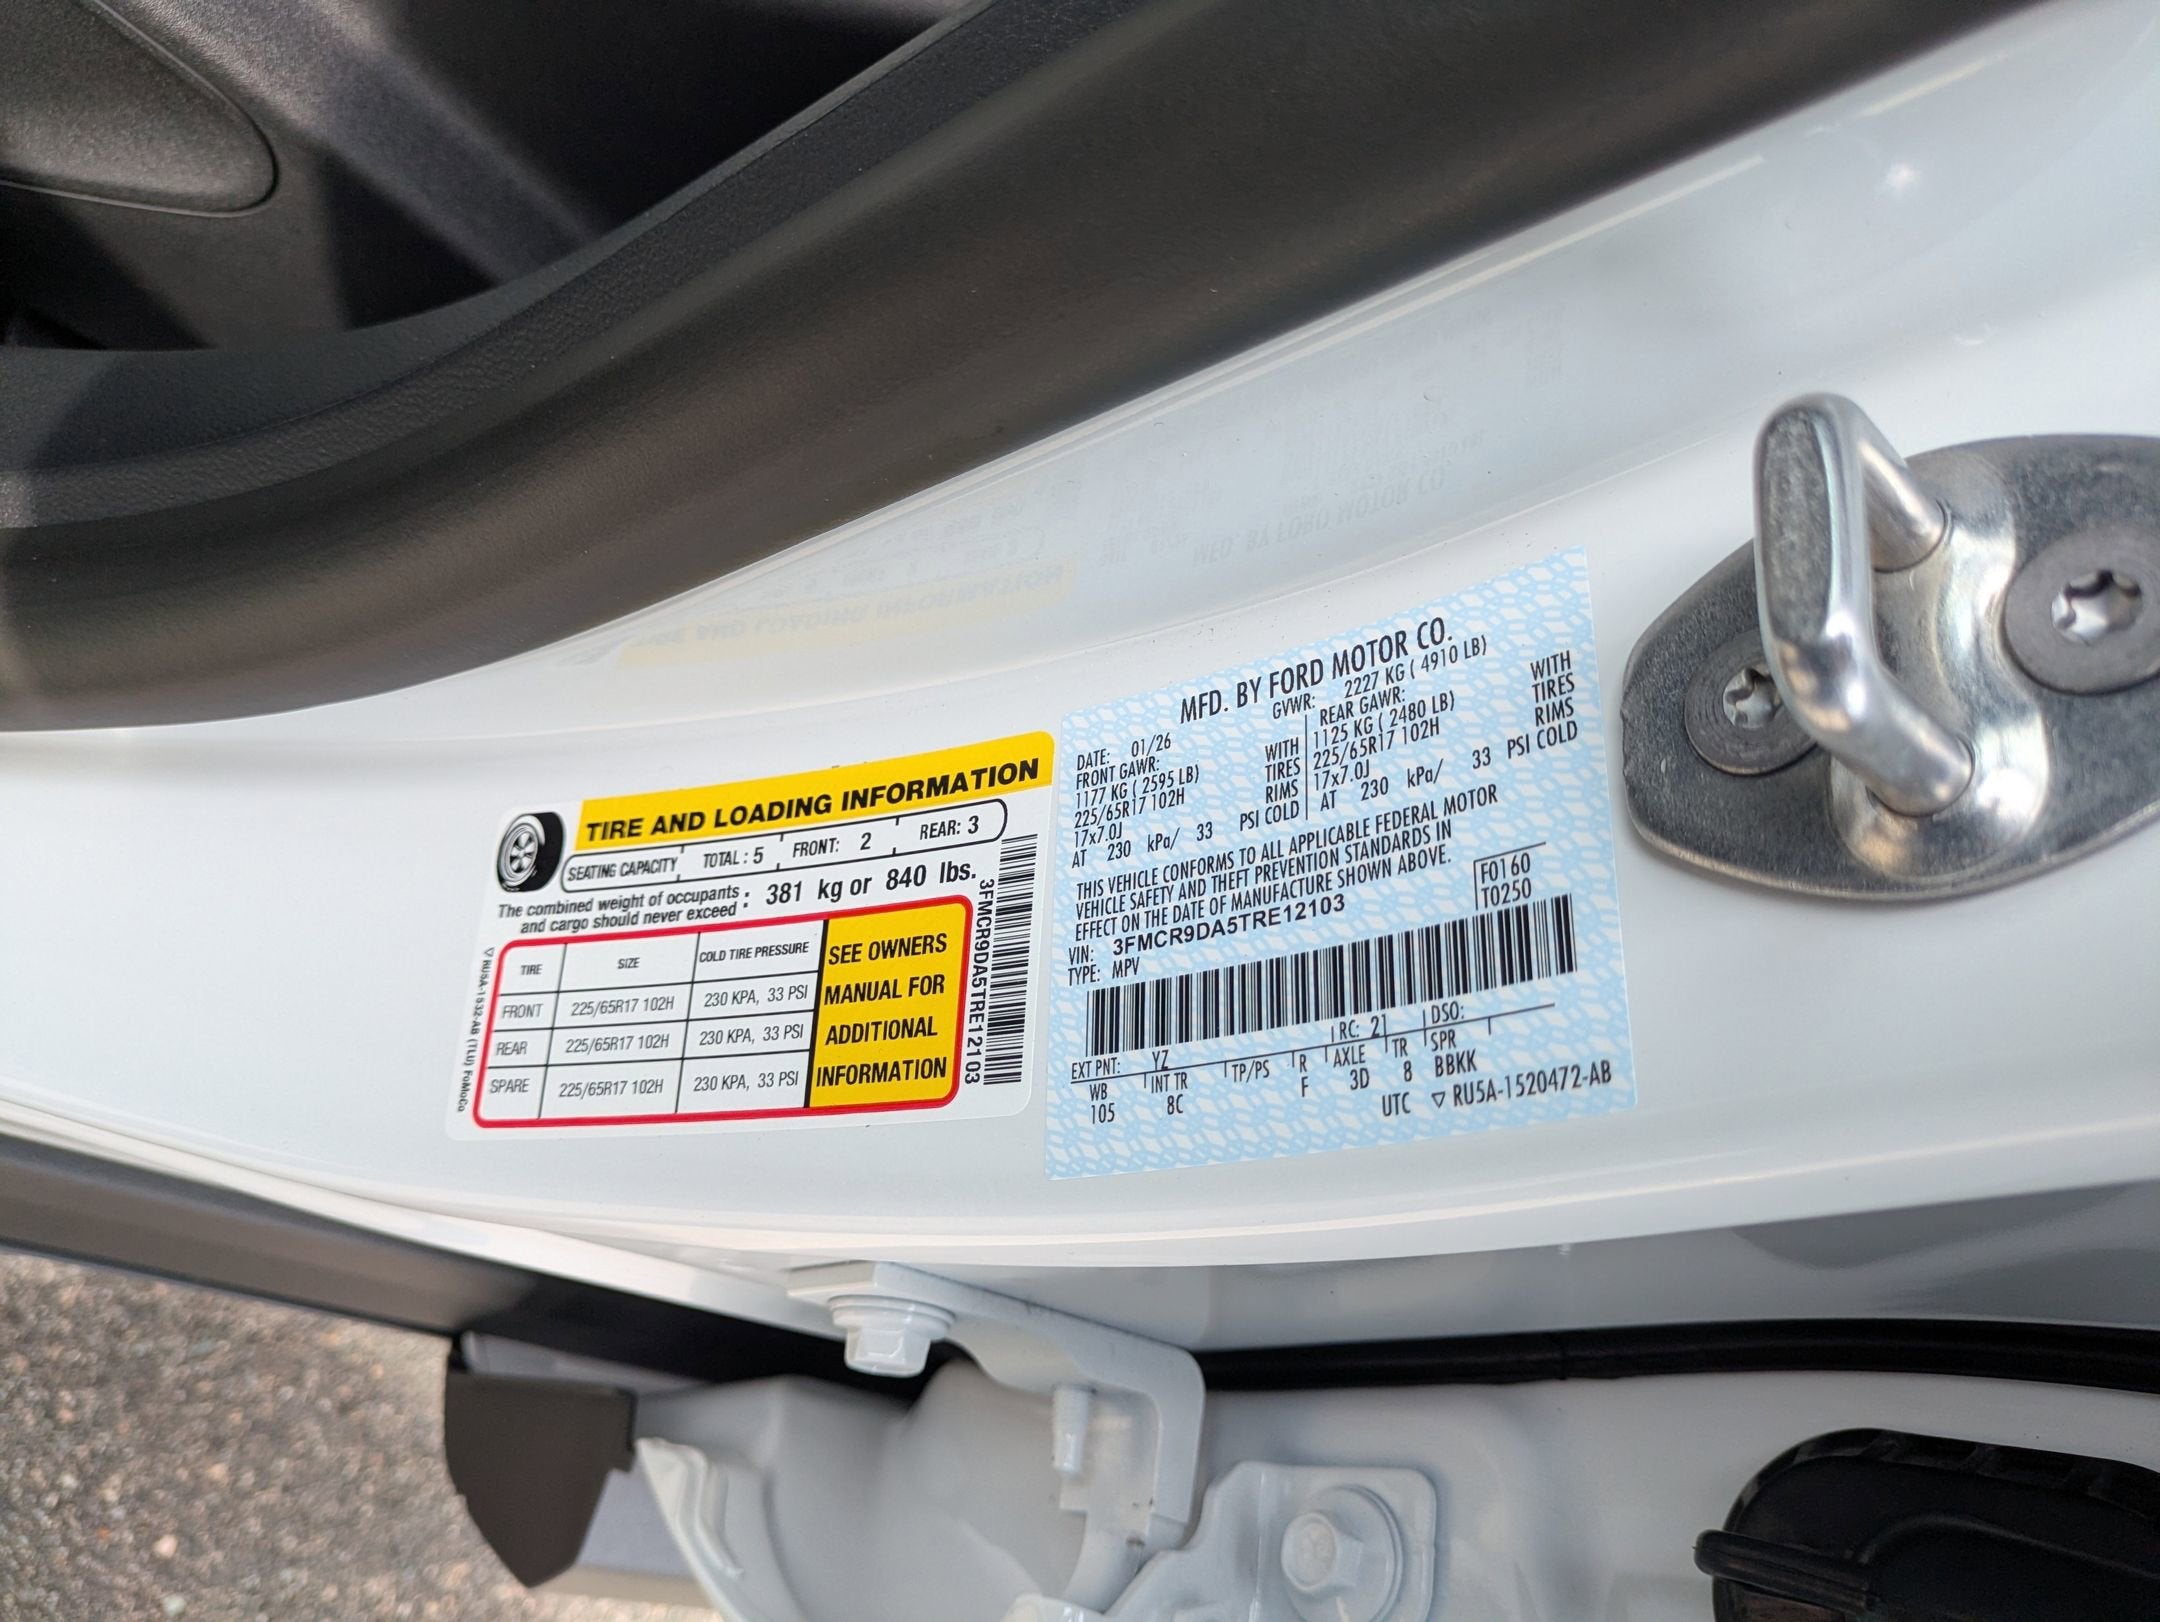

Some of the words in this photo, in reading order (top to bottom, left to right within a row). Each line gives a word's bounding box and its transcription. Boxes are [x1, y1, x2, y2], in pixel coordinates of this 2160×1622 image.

[1180, 689, 1229, 724] MFD.
[1236, 676, 1262, 708] BY
[1269, 659, 1324, 698] FORD
[1332, 630, 1408, 679] MOTOR
[1417, 617, 1453, 650] CO.
[1272, 693, 1316, 719] GVWR:
[1344, 671, 1379, 698] 2227
[1385, 664, 1405, 685] KG
[1420, 645, 1458, 672] 4910
[1464, 635, 1487, 660] LB)
[1530, 650, 1571, 680] WITH
[1532, 672, 1575, 703] TIRES
[1314, 724, 1348, 749] 1125
[1354, 717, 1373, 737] KG
[1390, 700, 1427, 728] 2480
[1432, 690, 1455, 714] LB)
[1320, 700, 1354, 726] REAR
[1359, 687, 1405, 716] GAWR:
[1534, 697, 1574, 727] RIMS
[1077, 748, 1110, 771] DATE:
[1131, 732, 1171, 757] 01/26
[1265, 737, 1299, 762] WITH
[1313, 730, 1395, 770] 225/65R17
[1403, 717, 1440, 745] 102H
[1076, 765, 1114, 790] FRONT
[1120, 756, 1160, 780] GAWR:
[1265, 757, 1301, 783] TIRES
[1314, 760, 1370, 791] 17x7.0J
[1320, 790, 1337, 812] AT
[1360, 777, 1389, 801] 230
[1407, 759, 1443, 788] kPa/
[1472, 747, 1492, 769] 33
[1507, 734, 1530, 759] PSI
[1536, 721, 1578, 749] COLD
[586, 818, 645, 841] TIRE
[651, 812, 705, 835] AND
[714, 794, 832, 827] LOADING
[841, 758, 1038, 811] INFORMATION
[1076, 787, 1106, 809] 1177
[1111, 782, 1128, 801] KG
[1142, 773, 1174, 794] 2595
[1179, 764, 1199, 785] LB)
[1266, 780, 1298, 804] RIMS
[1074, 797, 1145, 828] 225/65R17
[1152, 787, 1185, 812] 102H
[919, 821, 961, 840] REAR:
[1072, 850, 1088, 869] AT
[1107, 840, 1131, 861] 230
[1147, 828, 1180, 852] kPa/
[1196, 822, 1213, 841] 33
[1240, 810, 1259, 831] PSI
[1265, 801, 1299, 825] COLD
[1074, 822, 1123, 848] 17x7.0J
[1077, 879, 1104, 900] THIS
[1108, 867, 1159, 894] VEHICLE
[1163, 851, 1234, 883] CONFORMS
[1239, 847, 1256, 867] TO
[1261, 840, 1284, 862] ALL
[1289, 818, 1370, 855] APPLICABLE
[1375, 801, 1438, 834] FEDERAL
[1443, 784, 1498, 816] MOTOR
[703, 852, 739, 868] TOTAL
[792, 838, 840, 858] FRONT:
[568, 862, 616, 882] SEATING
[620, 857, 678, 877] CAPACITY
[766, 880, 802, 905] 381
[818, 878, 843, 902] kg
[850, 877, 872, 895] or
[886, 864, 926, 891] 840
[939, 861, 976, 884] lbs.
[1076, 895, 1126, 920] VEHICLE
[1130, 884, 1174, 910] SAFETY
[1179, 878, 1207, 900] AND
[1211, 868, 1250, 892] THEFT
[1255, 848, 1340, 885] PREVENTION
[1345, 825, 1431, 864] STANDARDS
[1436, 819, 1452, 840] IN
[1481, 853, 1531, 884] F0160
[499, 905, 523, 918] The
[527, 897, 592, 916] combined
[597, 893, 645, 913] weight
[649, 891, 664, 905] of
[667, 885, 740, 908] occupants
[1075, 917, 1117, 941] EFFECT
[1144, 907, 1168, 929] THE
[1173, 900, 1205, 924] DATE
[1209, 896, 1227, 915] OF
[1231, 871, 1332, 912] MANUFACTURE
[1337, 857, 1392, 889] SHOWN
[1397, 844, 1451, 875] ABOVE.
[1481, 877, 1532, 908] T0250
[520, 920, 545, 934] and
[550, 917, 588, 933] cargo
[592, 910, 639, 928] should
[643, 908, 682, 925] never
[686, 902, 736, 919] exceed
[1069, 945, 1094, 965] VIN:
[1113, 893, 1345, 956] 3FMCR9DA5TRE12103
[617, 958, 640, 969] SIZE
[699, 949, 726, 962] COLD
[729, 947, 752, 960] TIRE
[754, 941, 809, 957] PRESSURE
[828, 943, 863, 965] SEE
[868, 932, 948, 961] OWNERS
[520, 964, 543, 975] TIRE
[964, 879, 994, 1085] 3FMCR9DA5TRE12103
[1068, 965, 1101, 986] TYPE:
[1112, 957, 1140, 979] MPV
[501, 1003, 544, 1019] FRONT
[571, 998, 639, 1017] 225/65R17
[644, 996, 675, 1012] 102H
[704, 992, 728, 1007] 230
[731, 989, 760, 1005] KPA,
[768, 987, 784, 1002] 33
[788, 985, 808, 1000] PSI
[823, 978, 902, 1005] MANUAL
[908, 974, 945, 997] FOR
[1431, 1001, 1464, 1025] DSO:
[495, 1041, 528, 1056] REAR
[565, 1036, 634, 1055] 225/65R17
[638, 1034, 670, 1050] 102H
[699, 1030, 723, 1046] 230
[727, 1028, 755, 1044] KPA,
[763, 1026, 780, 1041] 33
[784, 1024, 803, 1039] PSI
[825, 1015, 937, 1045] ADDITIONAL
[1339, 1019, 1359, 1040] RC:
[1431, 1029, 1456, 1052] SPR
[464, 1039, 479, 1066] (TLU)
[1333, 1045, 1365, 1068] AXLE
[1435, 1049, 1477, 1077] BBKK
[816, 1057, 947, 1087] INFORMATION
[1071, 1060, 1093, 1080] EXT
[1095, 1057, 1120, 1077] PNT:
[1151, 1074, 1170, 1094] INT
[1175, 1072, 1188, 1090] TR
[1232, 1060, 1270, 1083] TP/PS
[458, 1070, 473, 1112] FoMoCo
[489, 1078, 530, 1094] SPARE
[559, 1081, 627, 1099] 225/65R17
[632, 1079, 664, 1095] 102H
[694, 1076, 717, 1092] 230
[721, 1074, 750, 1090] KPA,
[758, 1073, 775, 1088] 33
[778, 1071, 799, 1086] PSI
[1089, 1083, 1108, 1102] WB
[1382, 1092, 1411, 1117] UTC
[1453, 1060, 1612, 1107] RU5A-1520472-AB
[1091, 1103, 1115, 1124] 105
